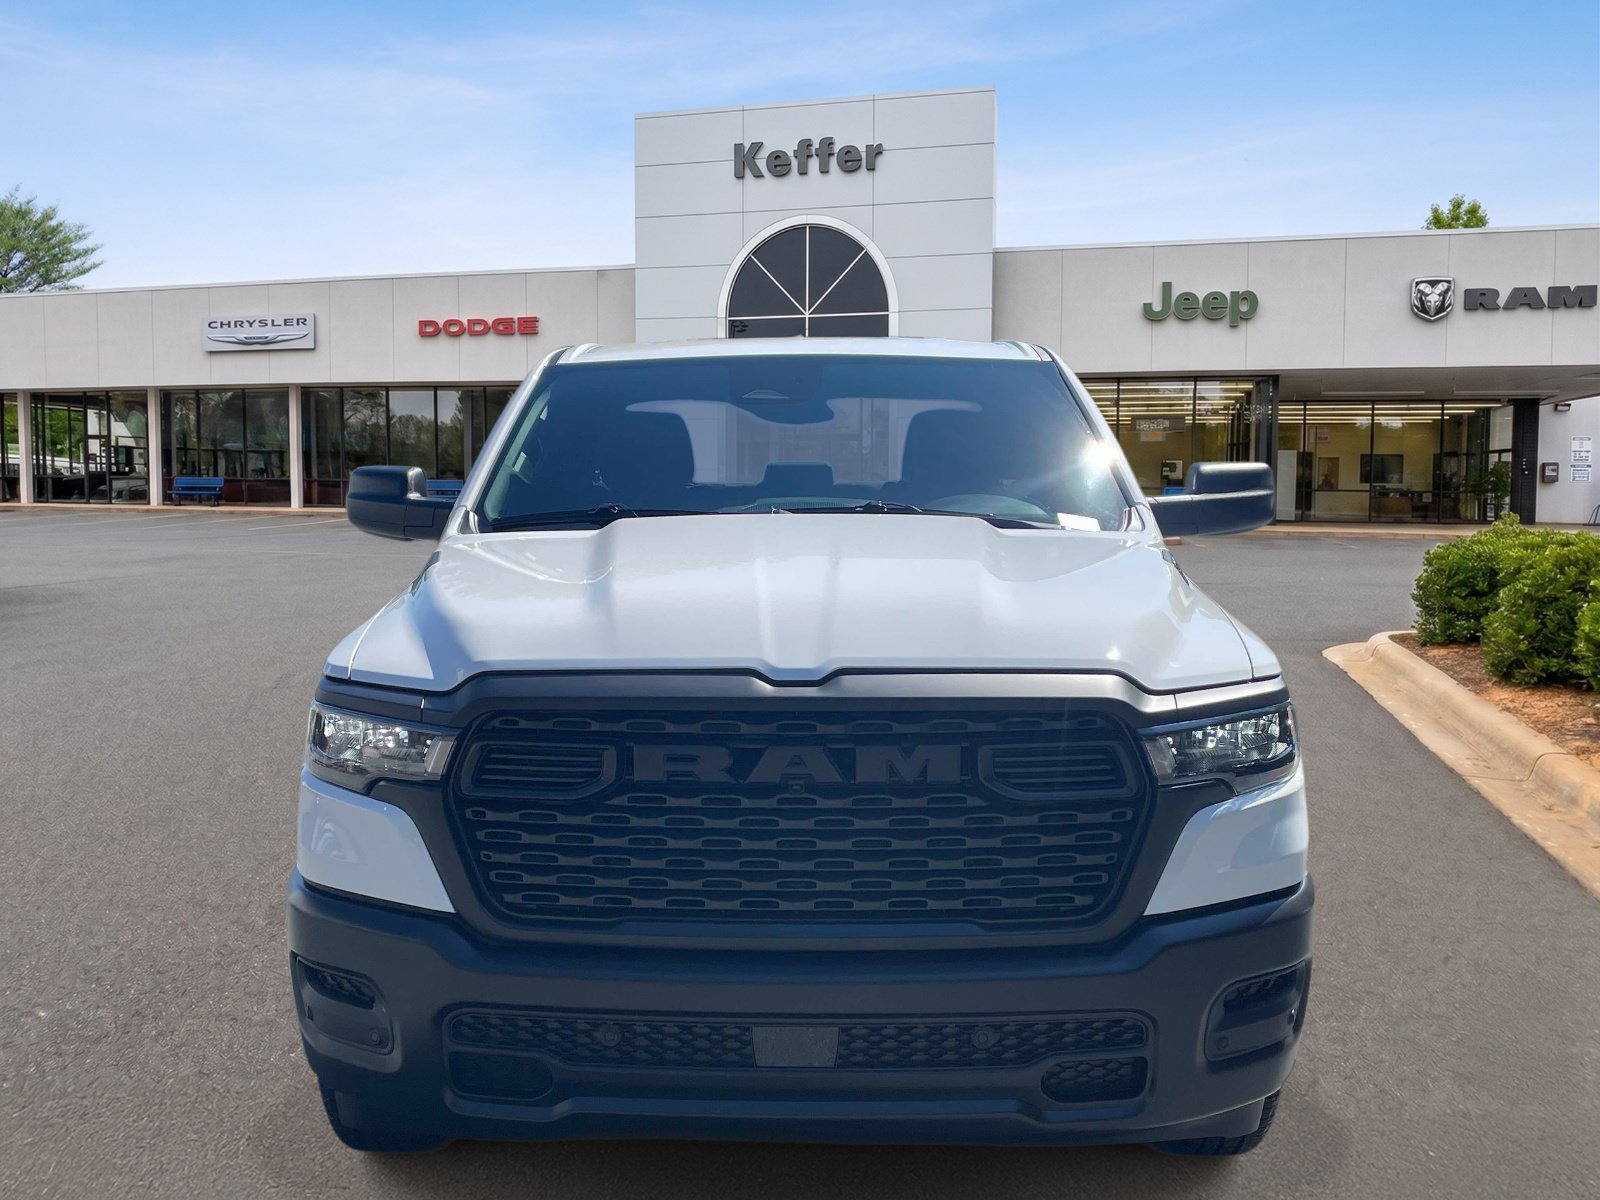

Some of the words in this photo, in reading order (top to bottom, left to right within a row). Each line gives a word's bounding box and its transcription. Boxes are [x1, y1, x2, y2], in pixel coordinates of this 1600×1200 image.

[734, 137, 883, 178] Keffer
[1143, 282, 1259, 327] Jeep
[1464, 285, 1597, 310] RAM
[207, 317, 308, 329] CHRYSLER
[418, 316, 539, 337] DODGE
[633, 744, 962, 784] RAM
